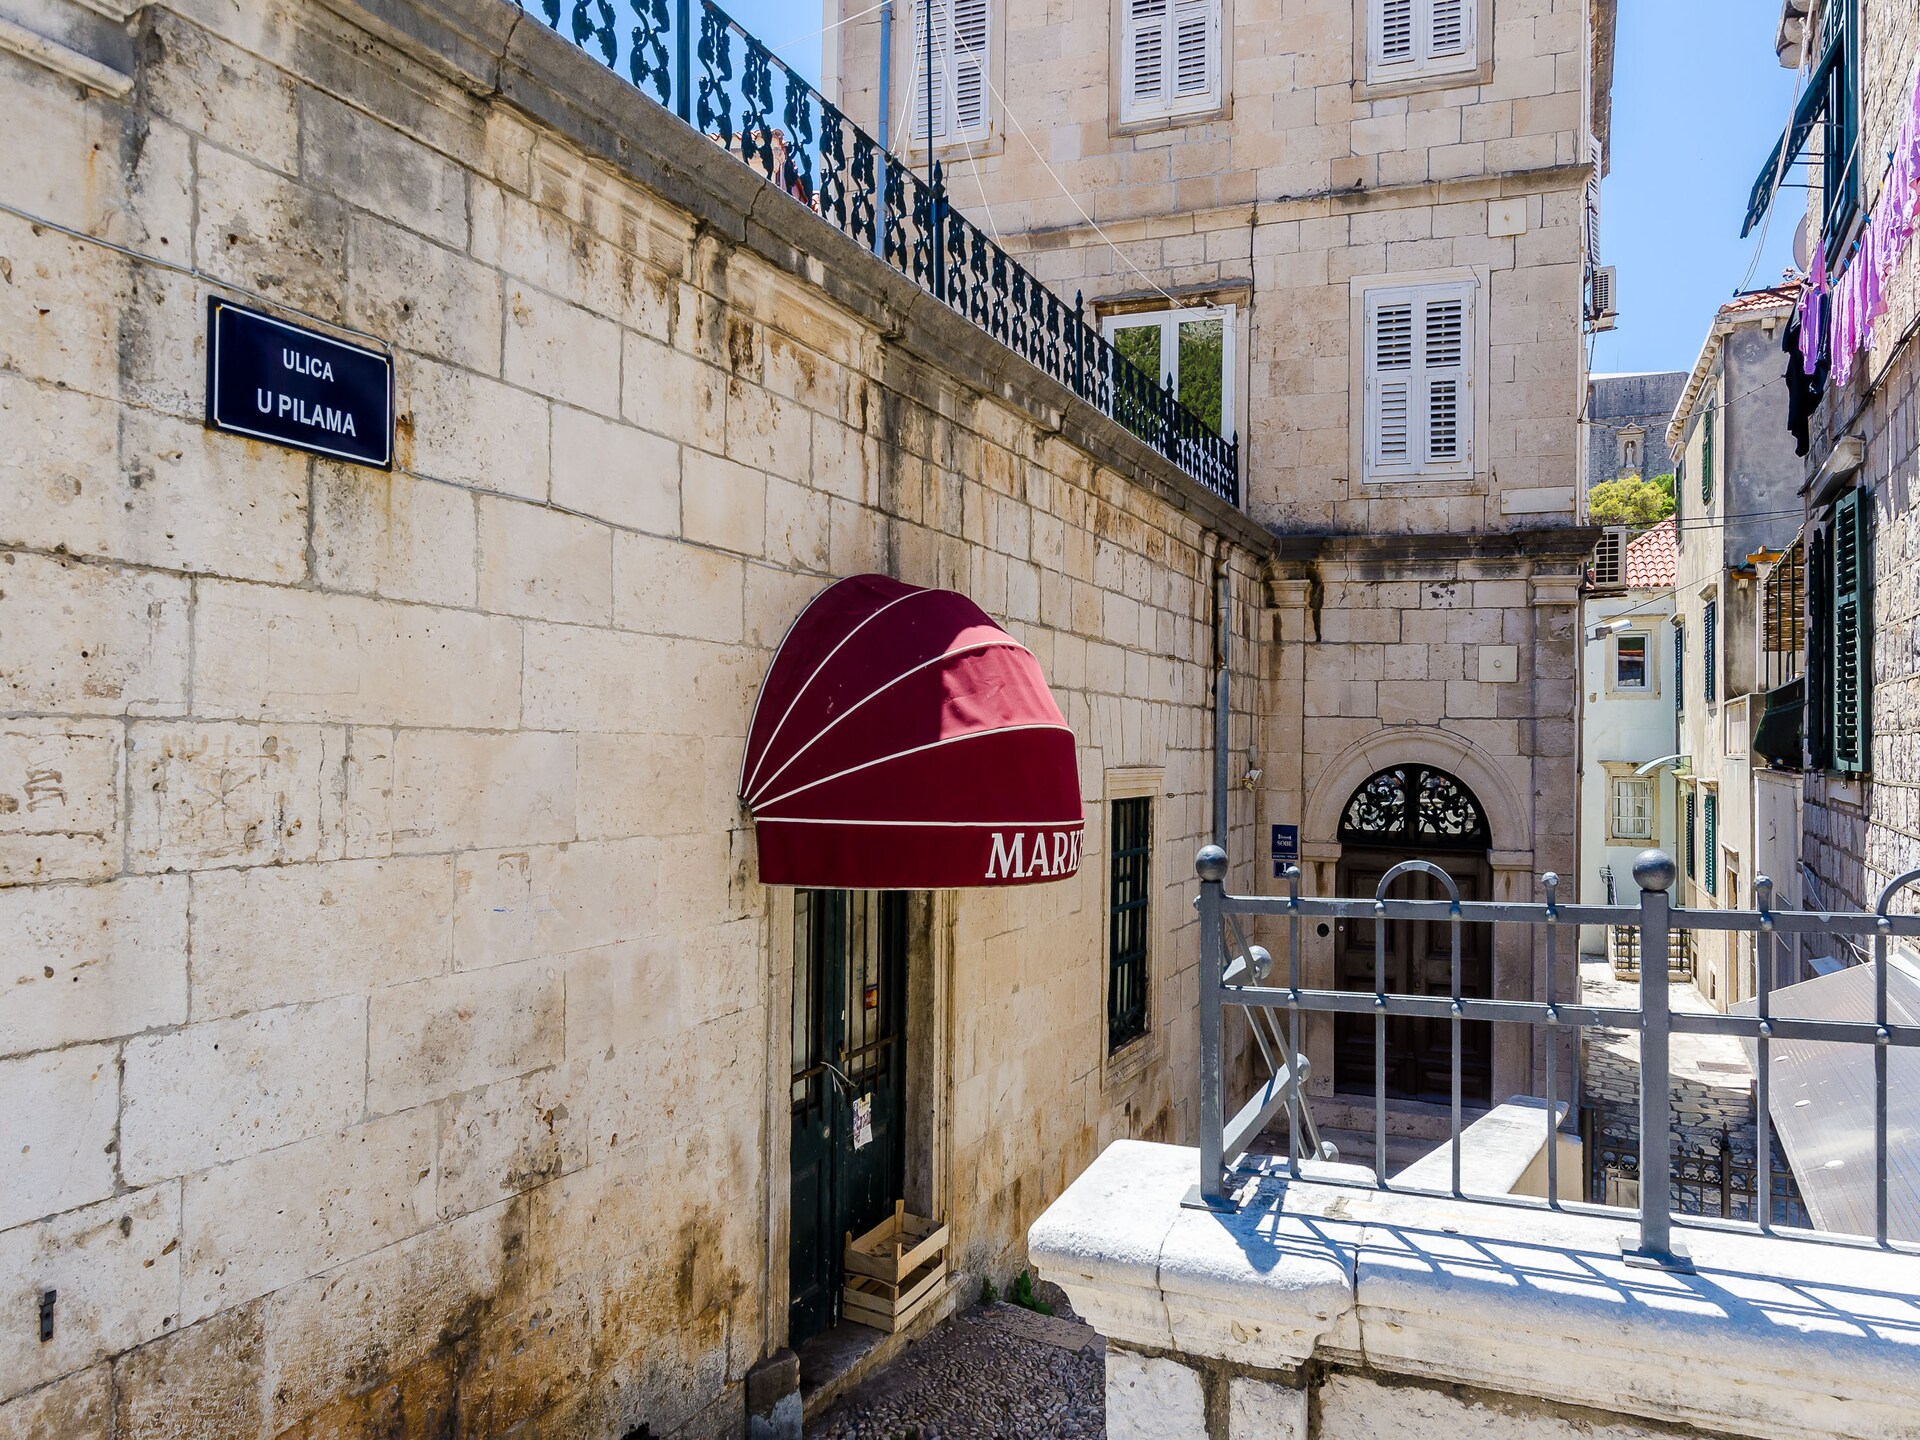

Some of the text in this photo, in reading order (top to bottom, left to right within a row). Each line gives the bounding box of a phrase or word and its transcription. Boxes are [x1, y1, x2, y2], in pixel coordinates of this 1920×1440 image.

[283, 348, 334, 382] ULICA
[257, 388, 356, 437] U PILAMA
